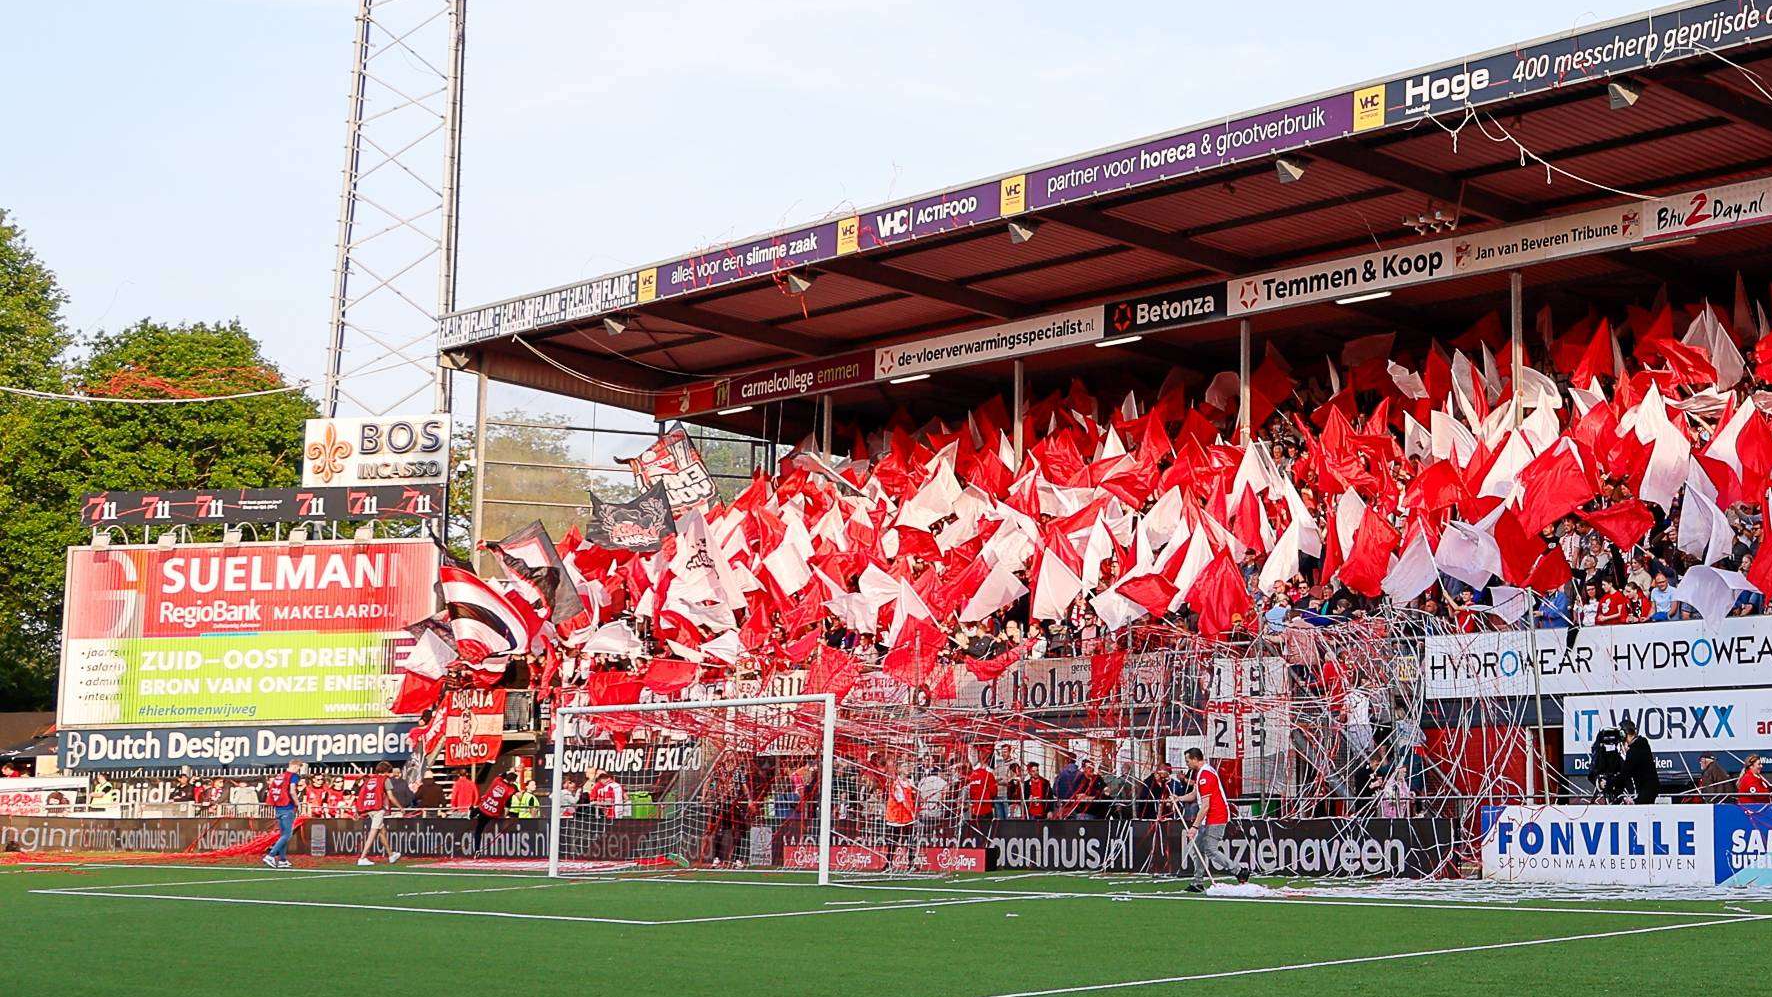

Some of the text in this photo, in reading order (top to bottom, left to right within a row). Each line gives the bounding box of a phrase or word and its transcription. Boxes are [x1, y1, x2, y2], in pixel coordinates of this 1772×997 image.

[1511, 56, 1549, 85] 400
[1555, 30, 1660, 77] messcherp
[1663, 4, 1760, 53] geprijsde
[1405, 67, 1490, 106] Hoge
[1360, 94, 1380, 109] VHC
[1047, 105, 1326, 198] partner voor horeca & grootverbruik
[1005, 183, 1021, 196] VHC
[876, 195, 978, 239] VHC ACTIFOOD
[1656, 189, 1766, 232] Bhv2Day.nl
[841, 224, 856, 237] VHC
[1474, 221, 1619, 262] Jan van Beveren Tribune
[671, 231, 819, 285] alles voor een slimme zaak
[601, 273, 630, 302] FLAIR
[1262, 249, 1444, 302] Temmen & Koop
[535, 292, 560, 318] FLAIR
[1136, 293, 1215, 326] Betonza
[471, 307, 495, 334] FLAIR
[897, 318, 1095, 368] de-vloerverwarmingsspecialist.nl
[741, 361, 860, 400] carmelcollege emmen
[359, 421, 444, 455] BOS
[357, 459, 443, 481] INCASSO
[88, 496, 118, 521] 711
[142, 496, 172, 520] 711
[195, 495, 225, 518] 711
[295, 492, 326, 517] 711
[349, 491, 379, 515] 711
[402, 490, 432, 514] 711
[159, 599, 262, 629] RegioBank
[1430, 646, 1593, 681] HYDROWEAR
[138, 677, 201, 697] BRON
[206, 676, 253, 694] VAN
[259, 675, 319, 695] ONZE
[137, 704, 257, 719] #hierkomenwijweg
[1574, 703, 1735, 742] IT WORXX
[88, 729, 161, 762] Dutch
[167, 729, 250, 765] Design
[562, 748, 644, 773] SCHUTRUPS
[1498, 821, 1696, 856] FONVILLE
[936, 847, 977, 872] EasyToys
[1499, 857, 1696, 870] SCHOONMAAKBEDRIJVEN
